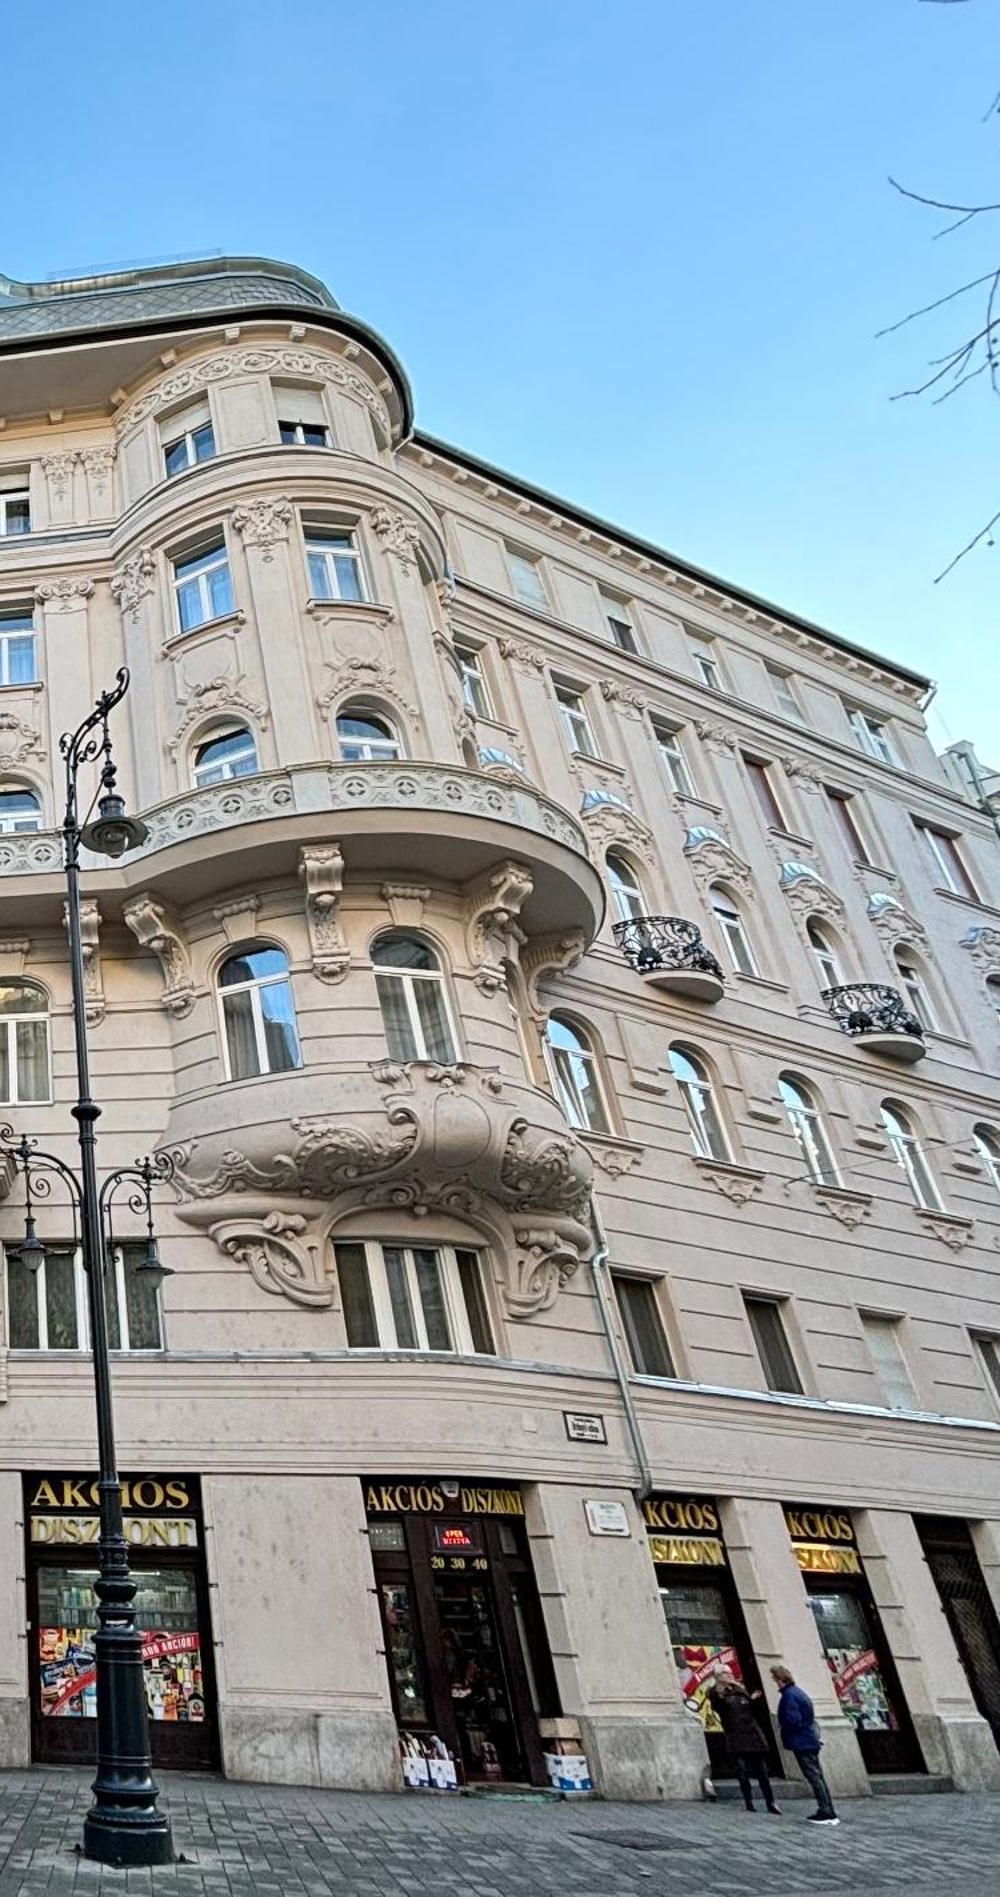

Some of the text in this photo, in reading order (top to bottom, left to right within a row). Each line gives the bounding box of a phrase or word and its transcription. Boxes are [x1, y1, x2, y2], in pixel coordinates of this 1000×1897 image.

[367, 1480, 525, 1516] AKCIÓS DISZKONT
[643, 1499, 718, 1531] KCIÓS
[786, 1509, 853, 1540] KCIÓS
[31, 1518, 195, 1547] DISZONT
[430, 1555, 445, 1569] 20
